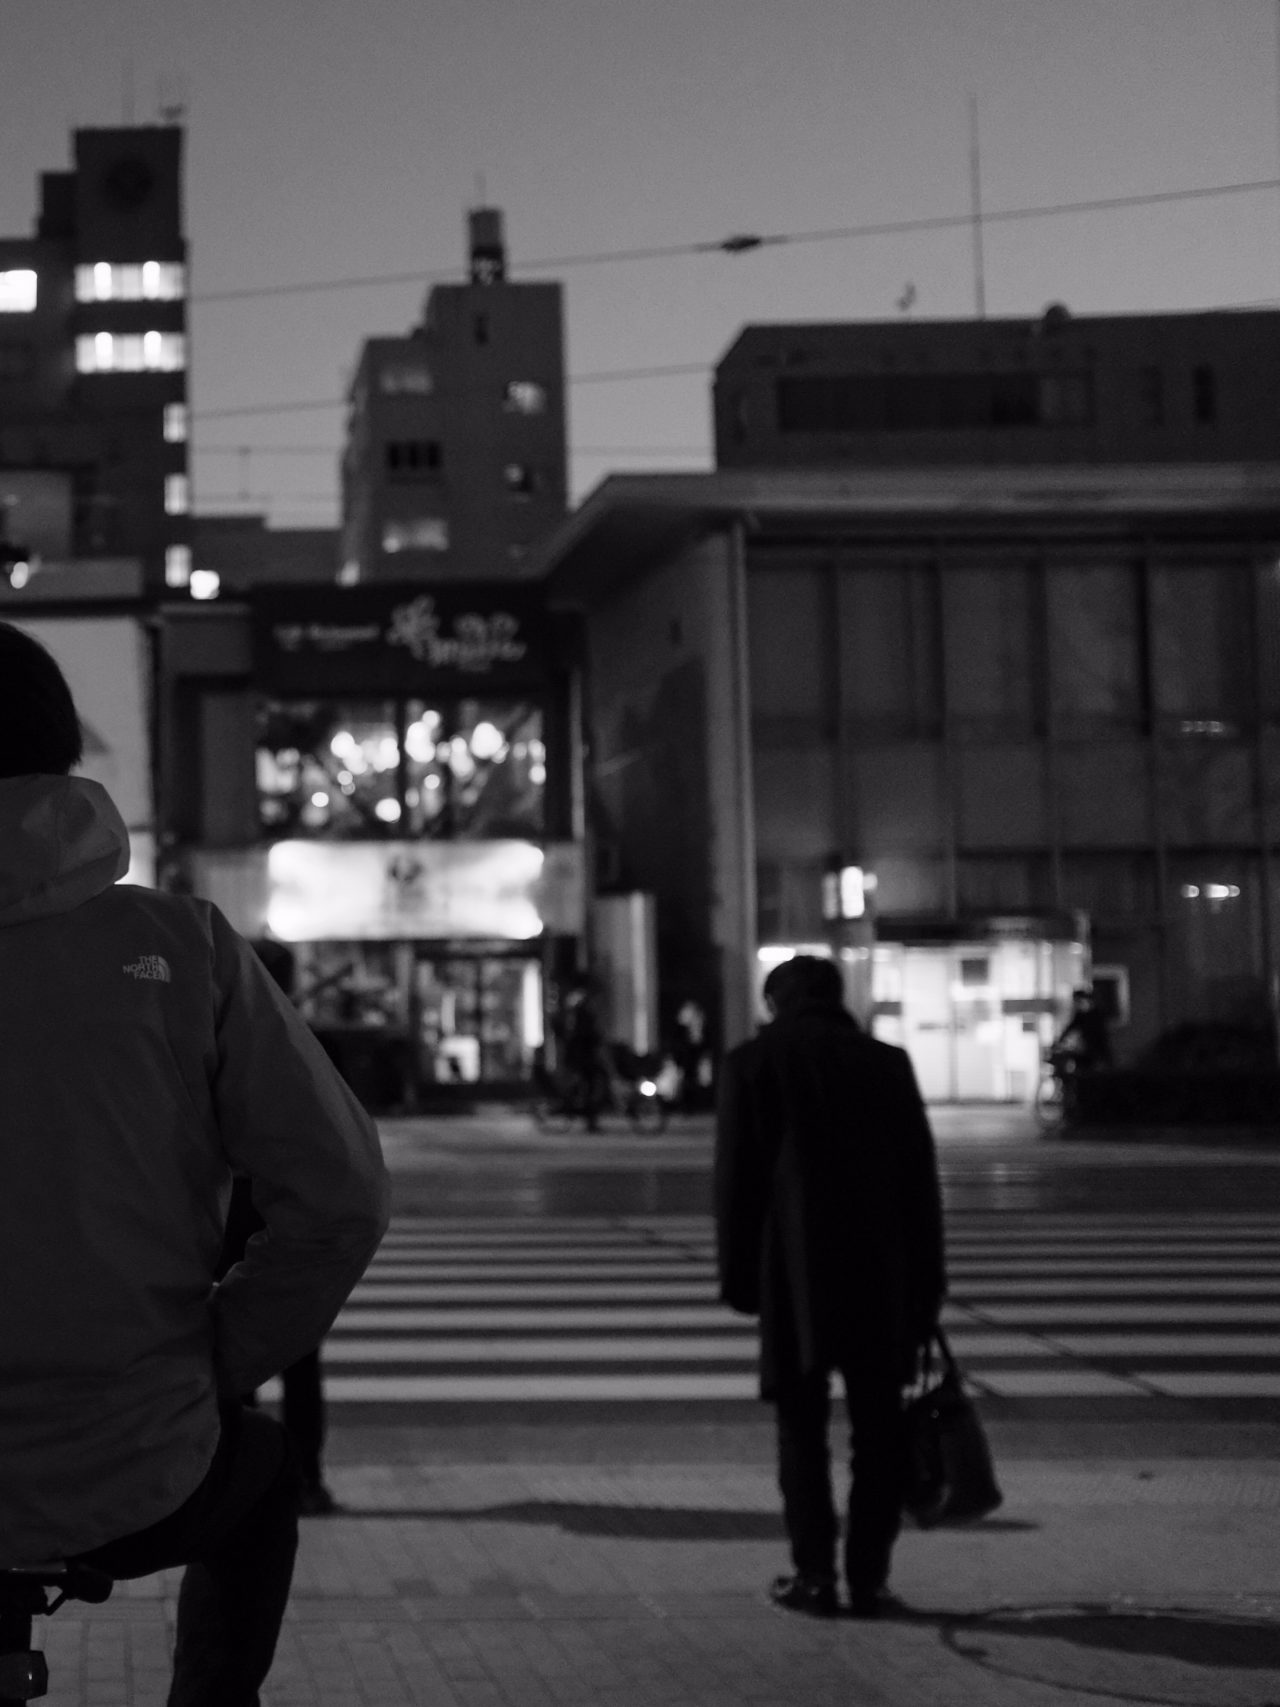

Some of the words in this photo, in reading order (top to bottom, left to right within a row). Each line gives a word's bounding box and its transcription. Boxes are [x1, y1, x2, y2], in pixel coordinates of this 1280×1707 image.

[138, 955, 158, 964] THE
[122, 961, 158, 974] NORTH
[134, 970, 160, 980] FACE
